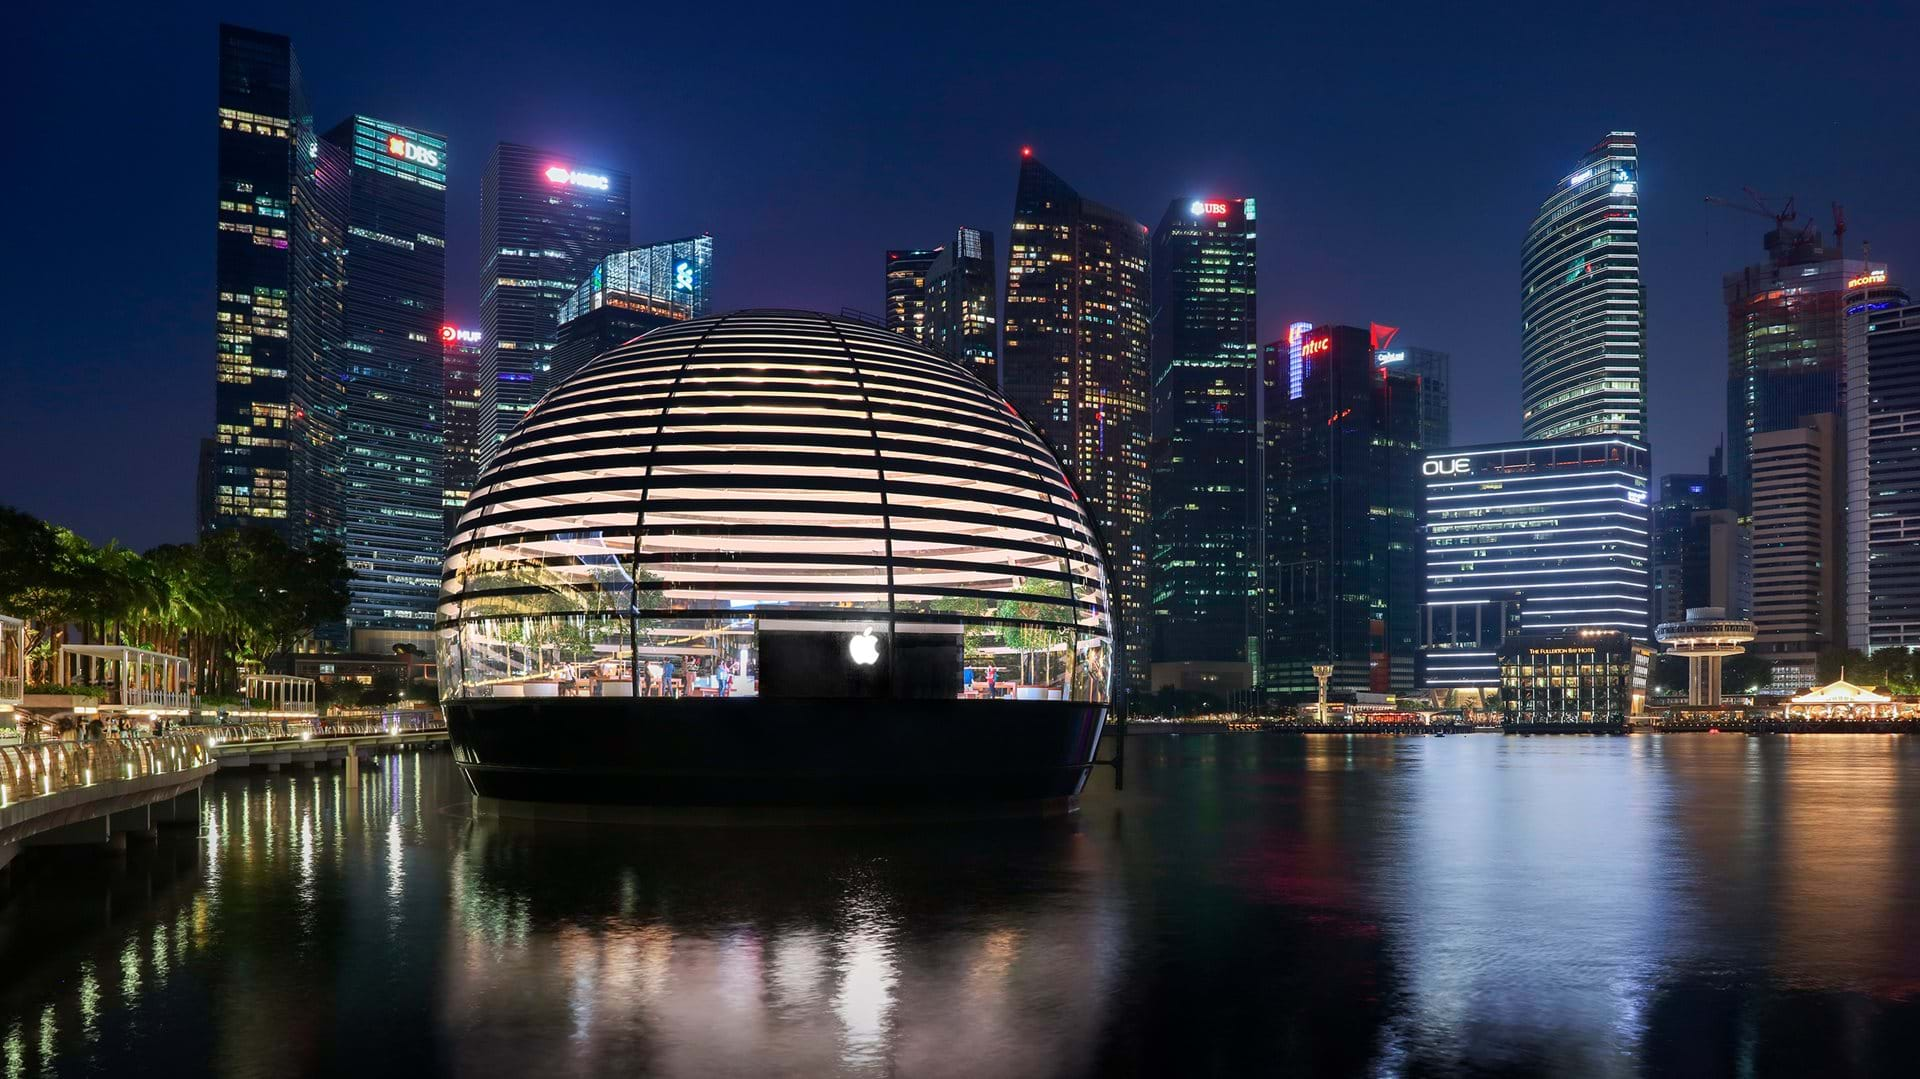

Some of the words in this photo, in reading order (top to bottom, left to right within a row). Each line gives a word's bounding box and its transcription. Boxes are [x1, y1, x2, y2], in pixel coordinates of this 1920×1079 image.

[405, 142, 439, 167] DBS
[1204, 203, 1226, 214] UBS
[457, 330, 482, 342] MUF
[1422, 458, 1471, 476] OUE
